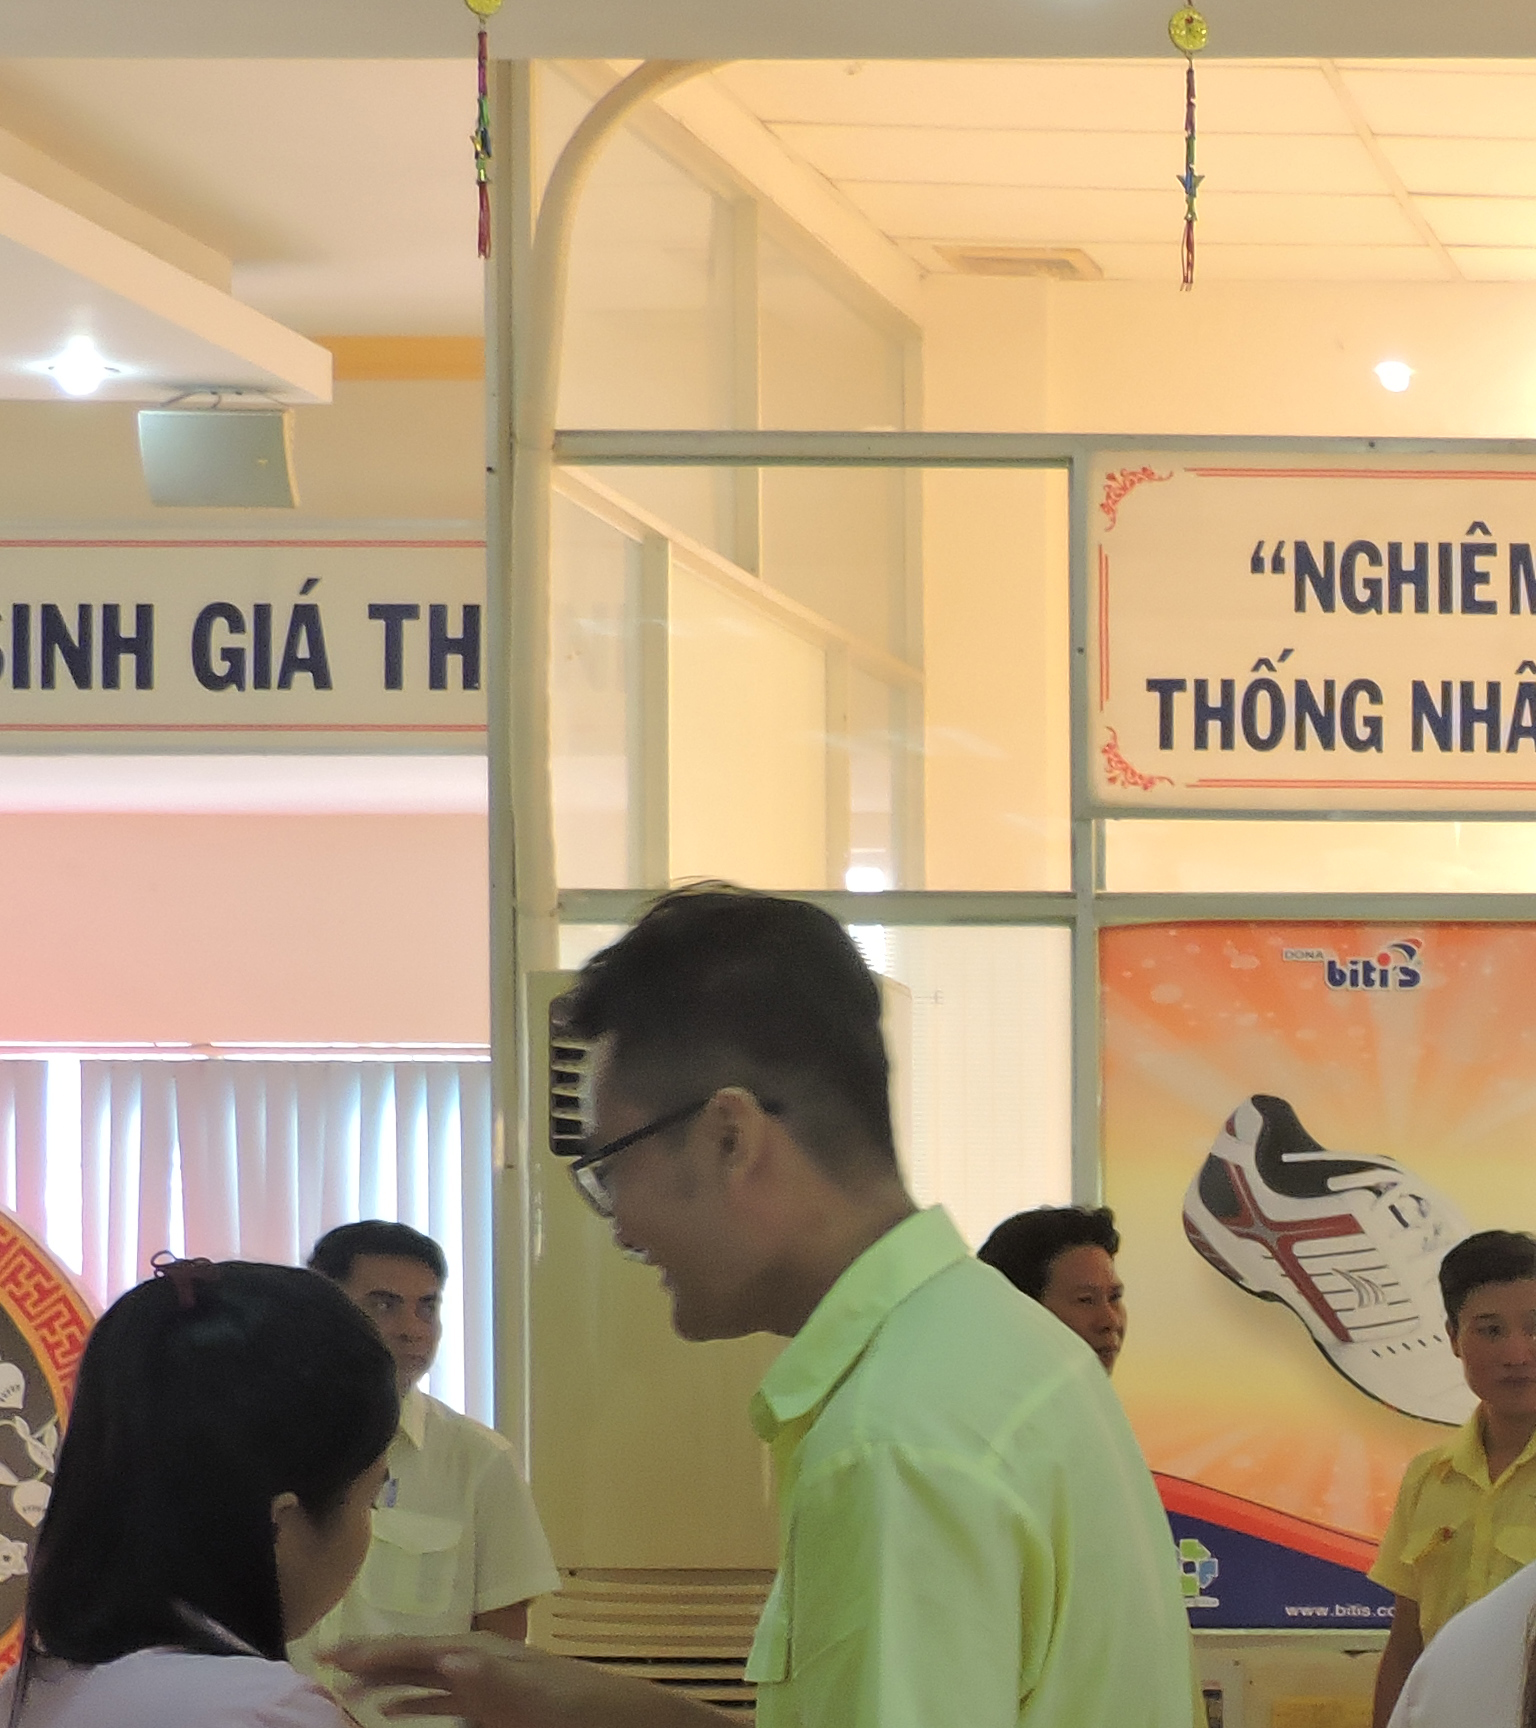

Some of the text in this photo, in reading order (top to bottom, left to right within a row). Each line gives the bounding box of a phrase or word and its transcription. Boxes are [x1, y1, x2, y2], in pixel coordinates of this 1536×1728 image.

[0, 602, 155, 691] INH
[191, 578, 333, 693] GIÁ
[1146, 648, 1383, 752] THỐNG
